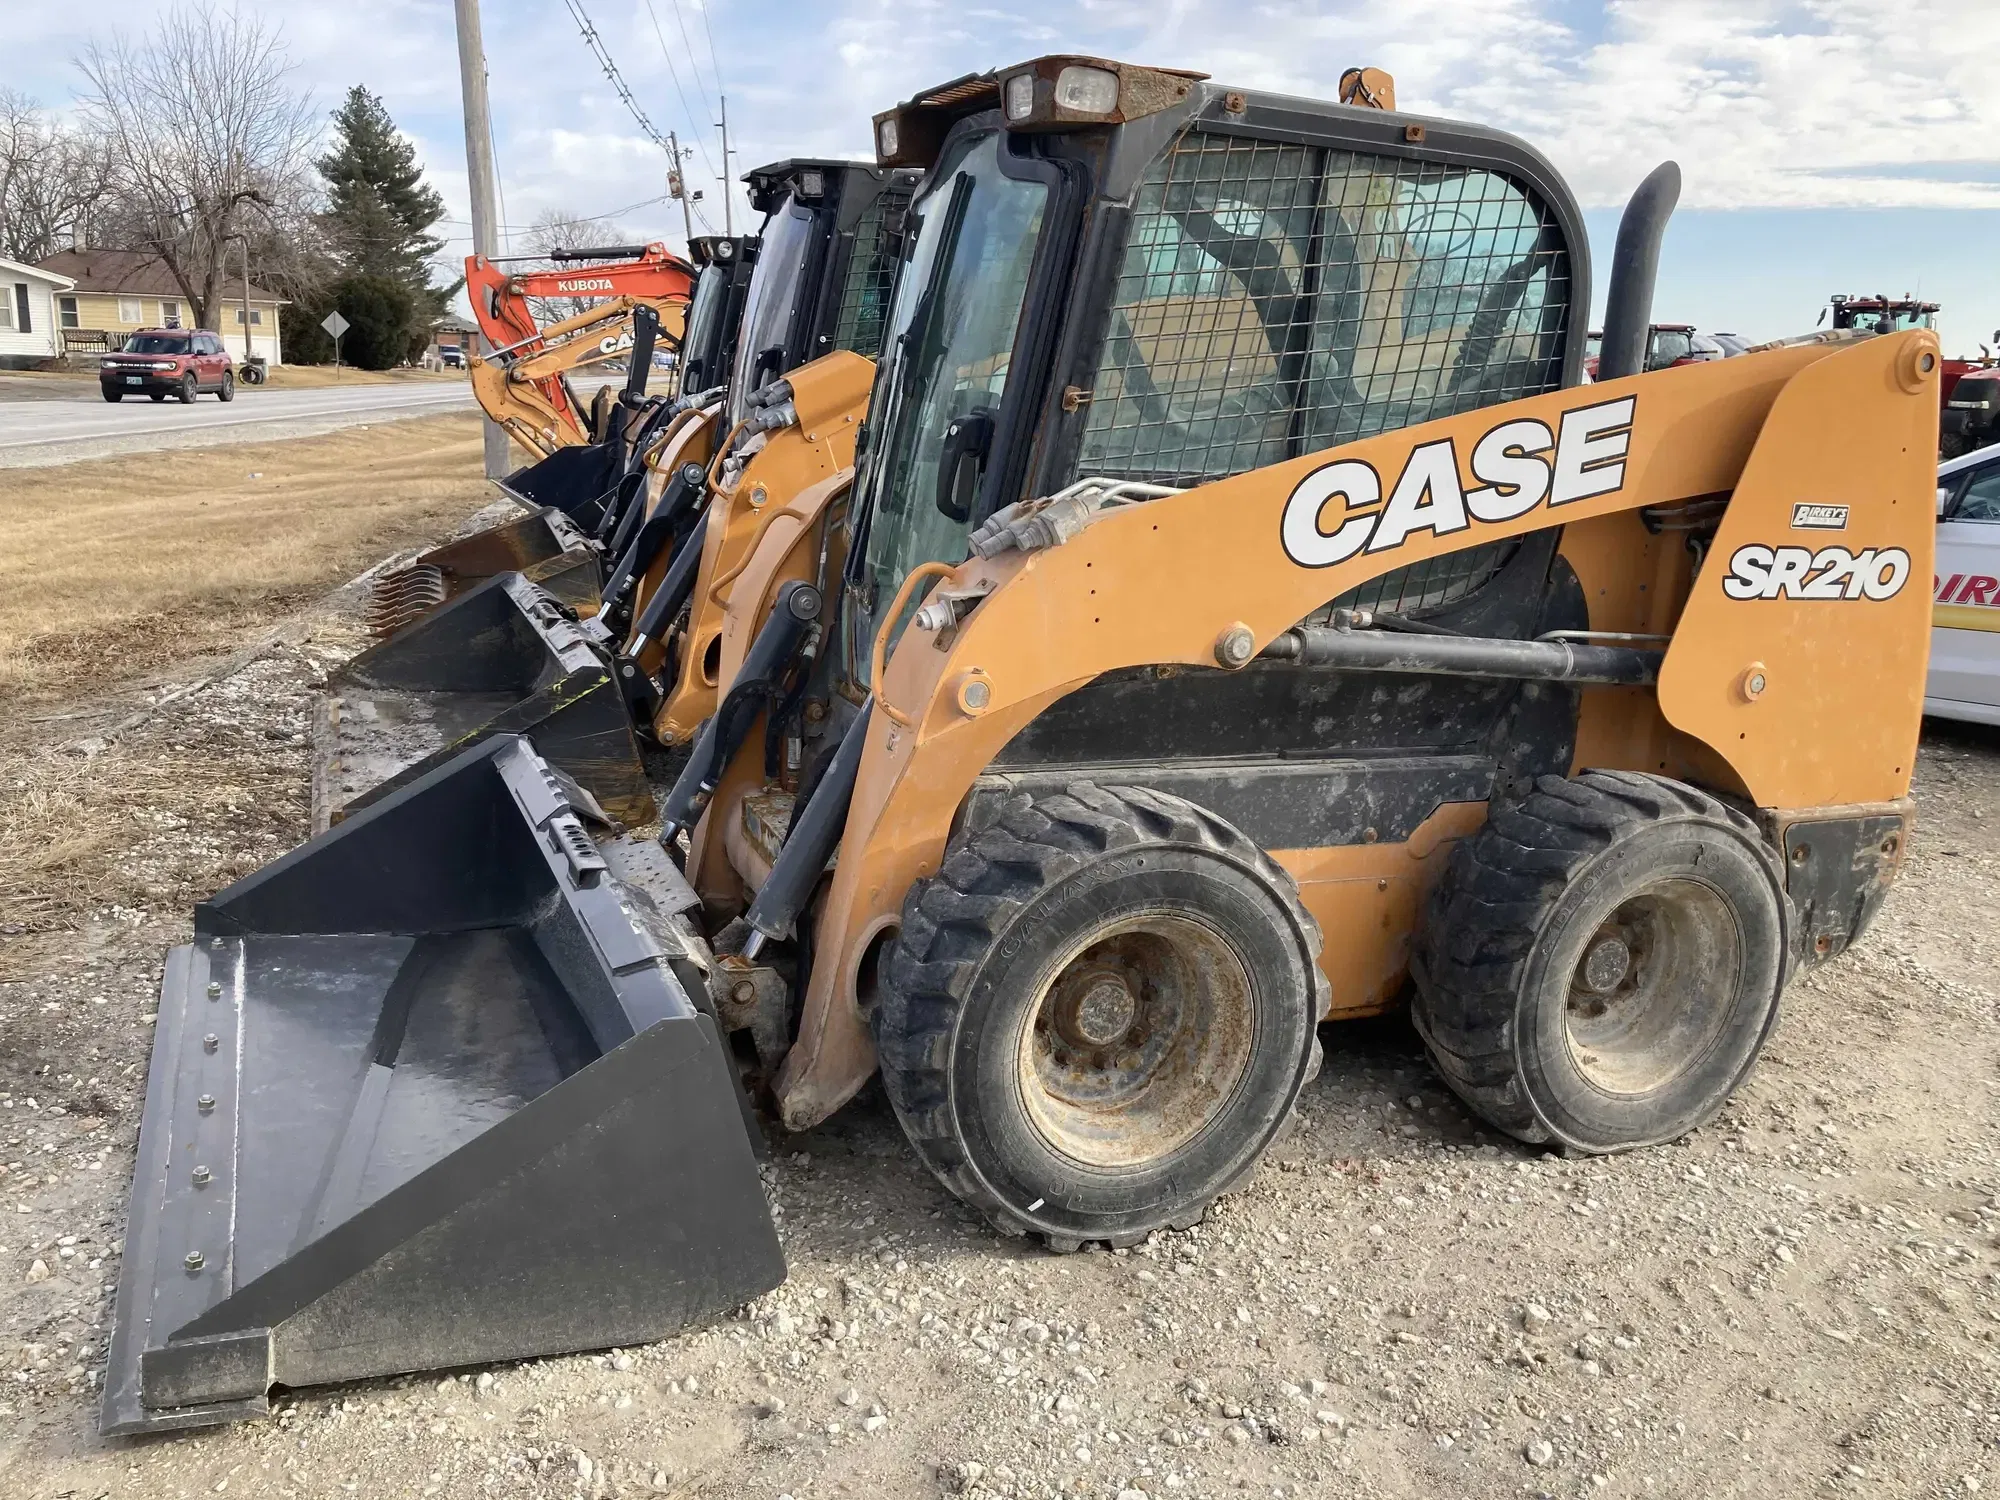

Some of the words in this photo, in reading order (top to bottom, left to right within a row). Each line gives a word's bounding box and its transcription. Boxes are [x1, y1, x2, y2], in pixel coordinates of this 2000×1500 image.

[558, 279, 614, 292] KUBOTA
[599, 328, 663, 354] CA
[1280, 394, 1638, 569] CASE
[1793, 506, 1848, 525] BIRKEY'S
[1722, 543, 1911, 601] SR210
[1934, 573, 2000, 608] IR
